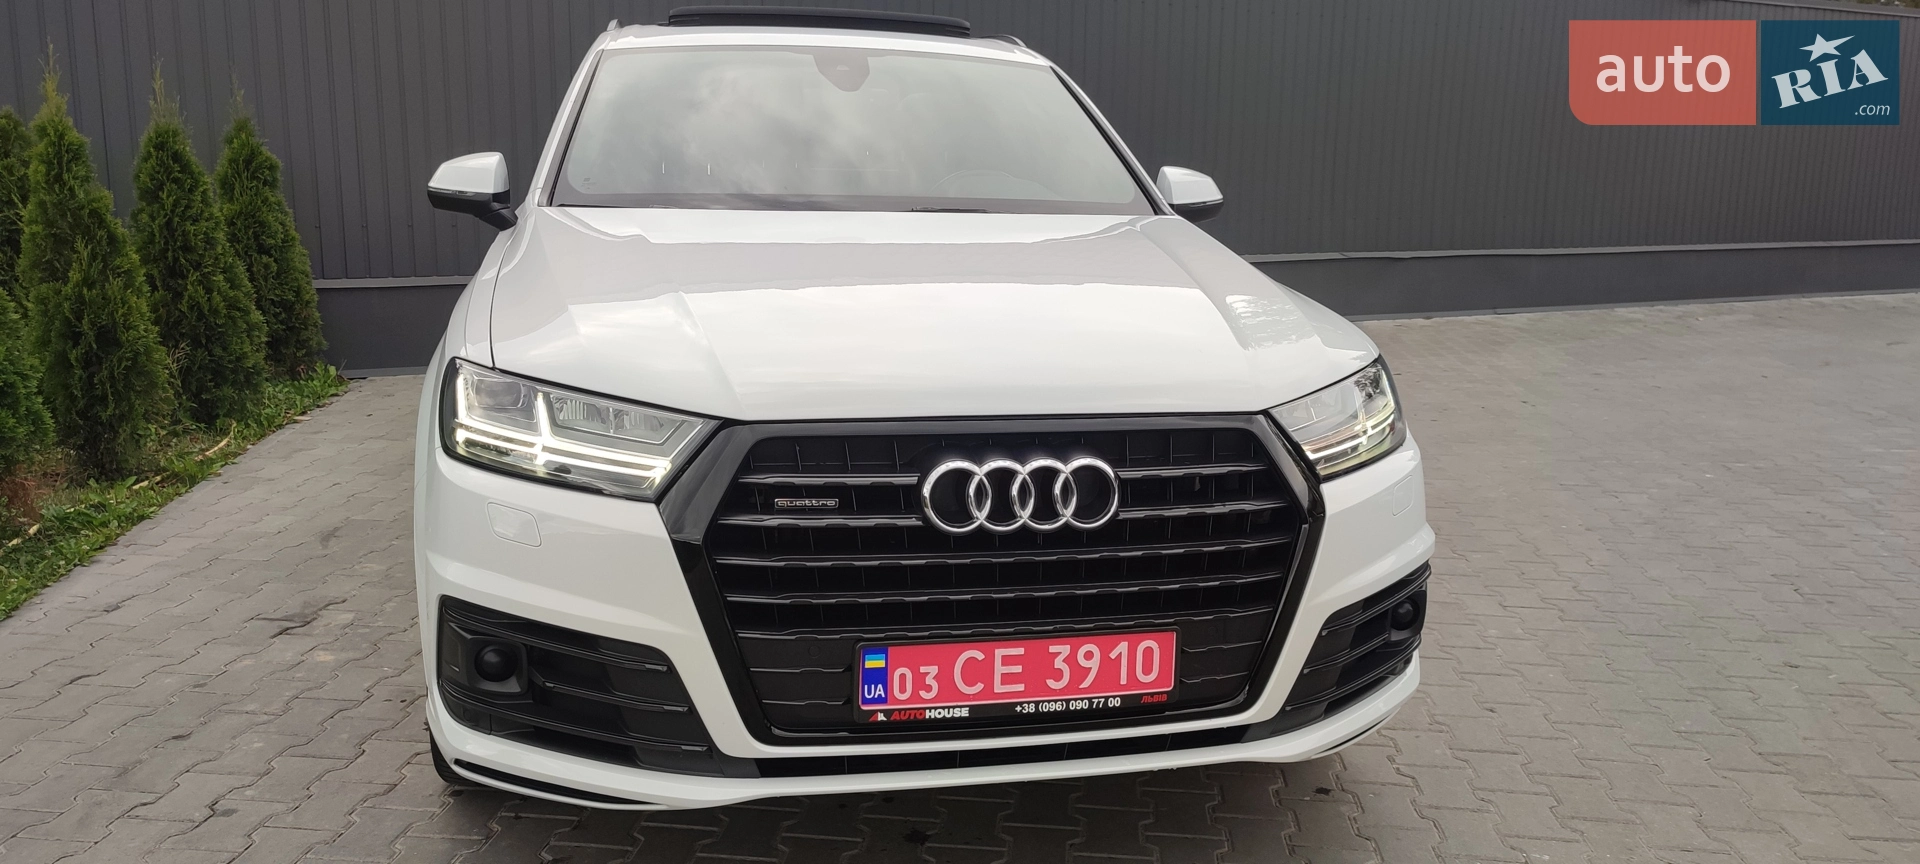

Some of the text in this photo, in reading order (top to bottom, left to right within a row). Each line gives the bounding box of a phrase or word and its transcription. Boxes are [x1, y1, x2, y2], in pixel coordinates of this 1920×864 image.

[777, 500, 836, 508] quattro
[893, 640, 1160, 700] 03 CE 3910
[864, 684, 885, 699] UA
[1015, 697, 1121, 714] +38 (096) 090 77 00
